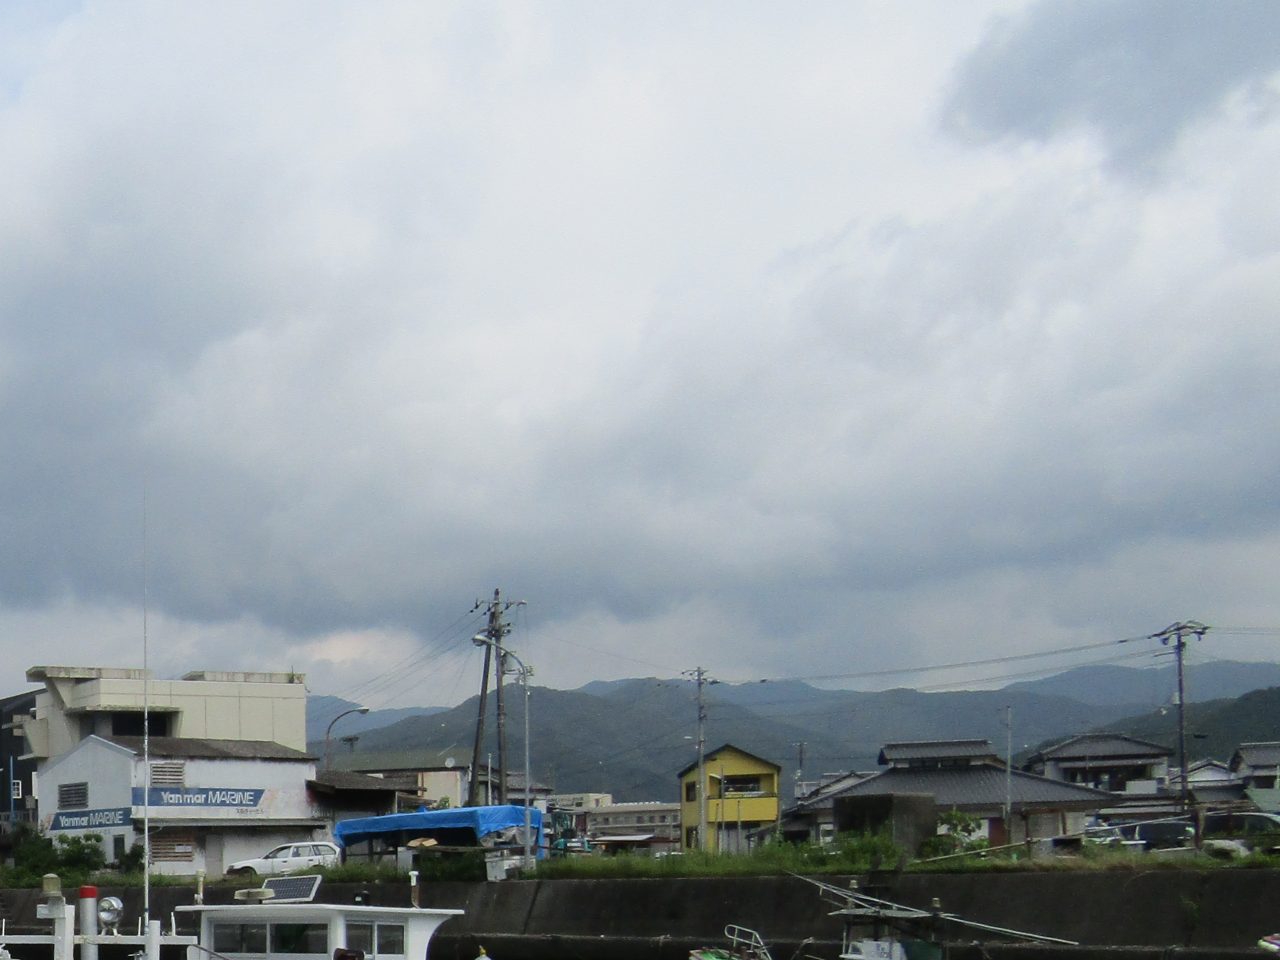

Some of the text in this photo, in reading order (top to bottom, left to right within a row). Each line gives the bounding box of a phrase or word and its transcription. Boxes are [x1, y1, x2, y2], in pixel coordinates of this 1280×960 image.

[161, 791, 255, 805] Yanmar MARINE
[59, 815, 89, 828] Yanmar
